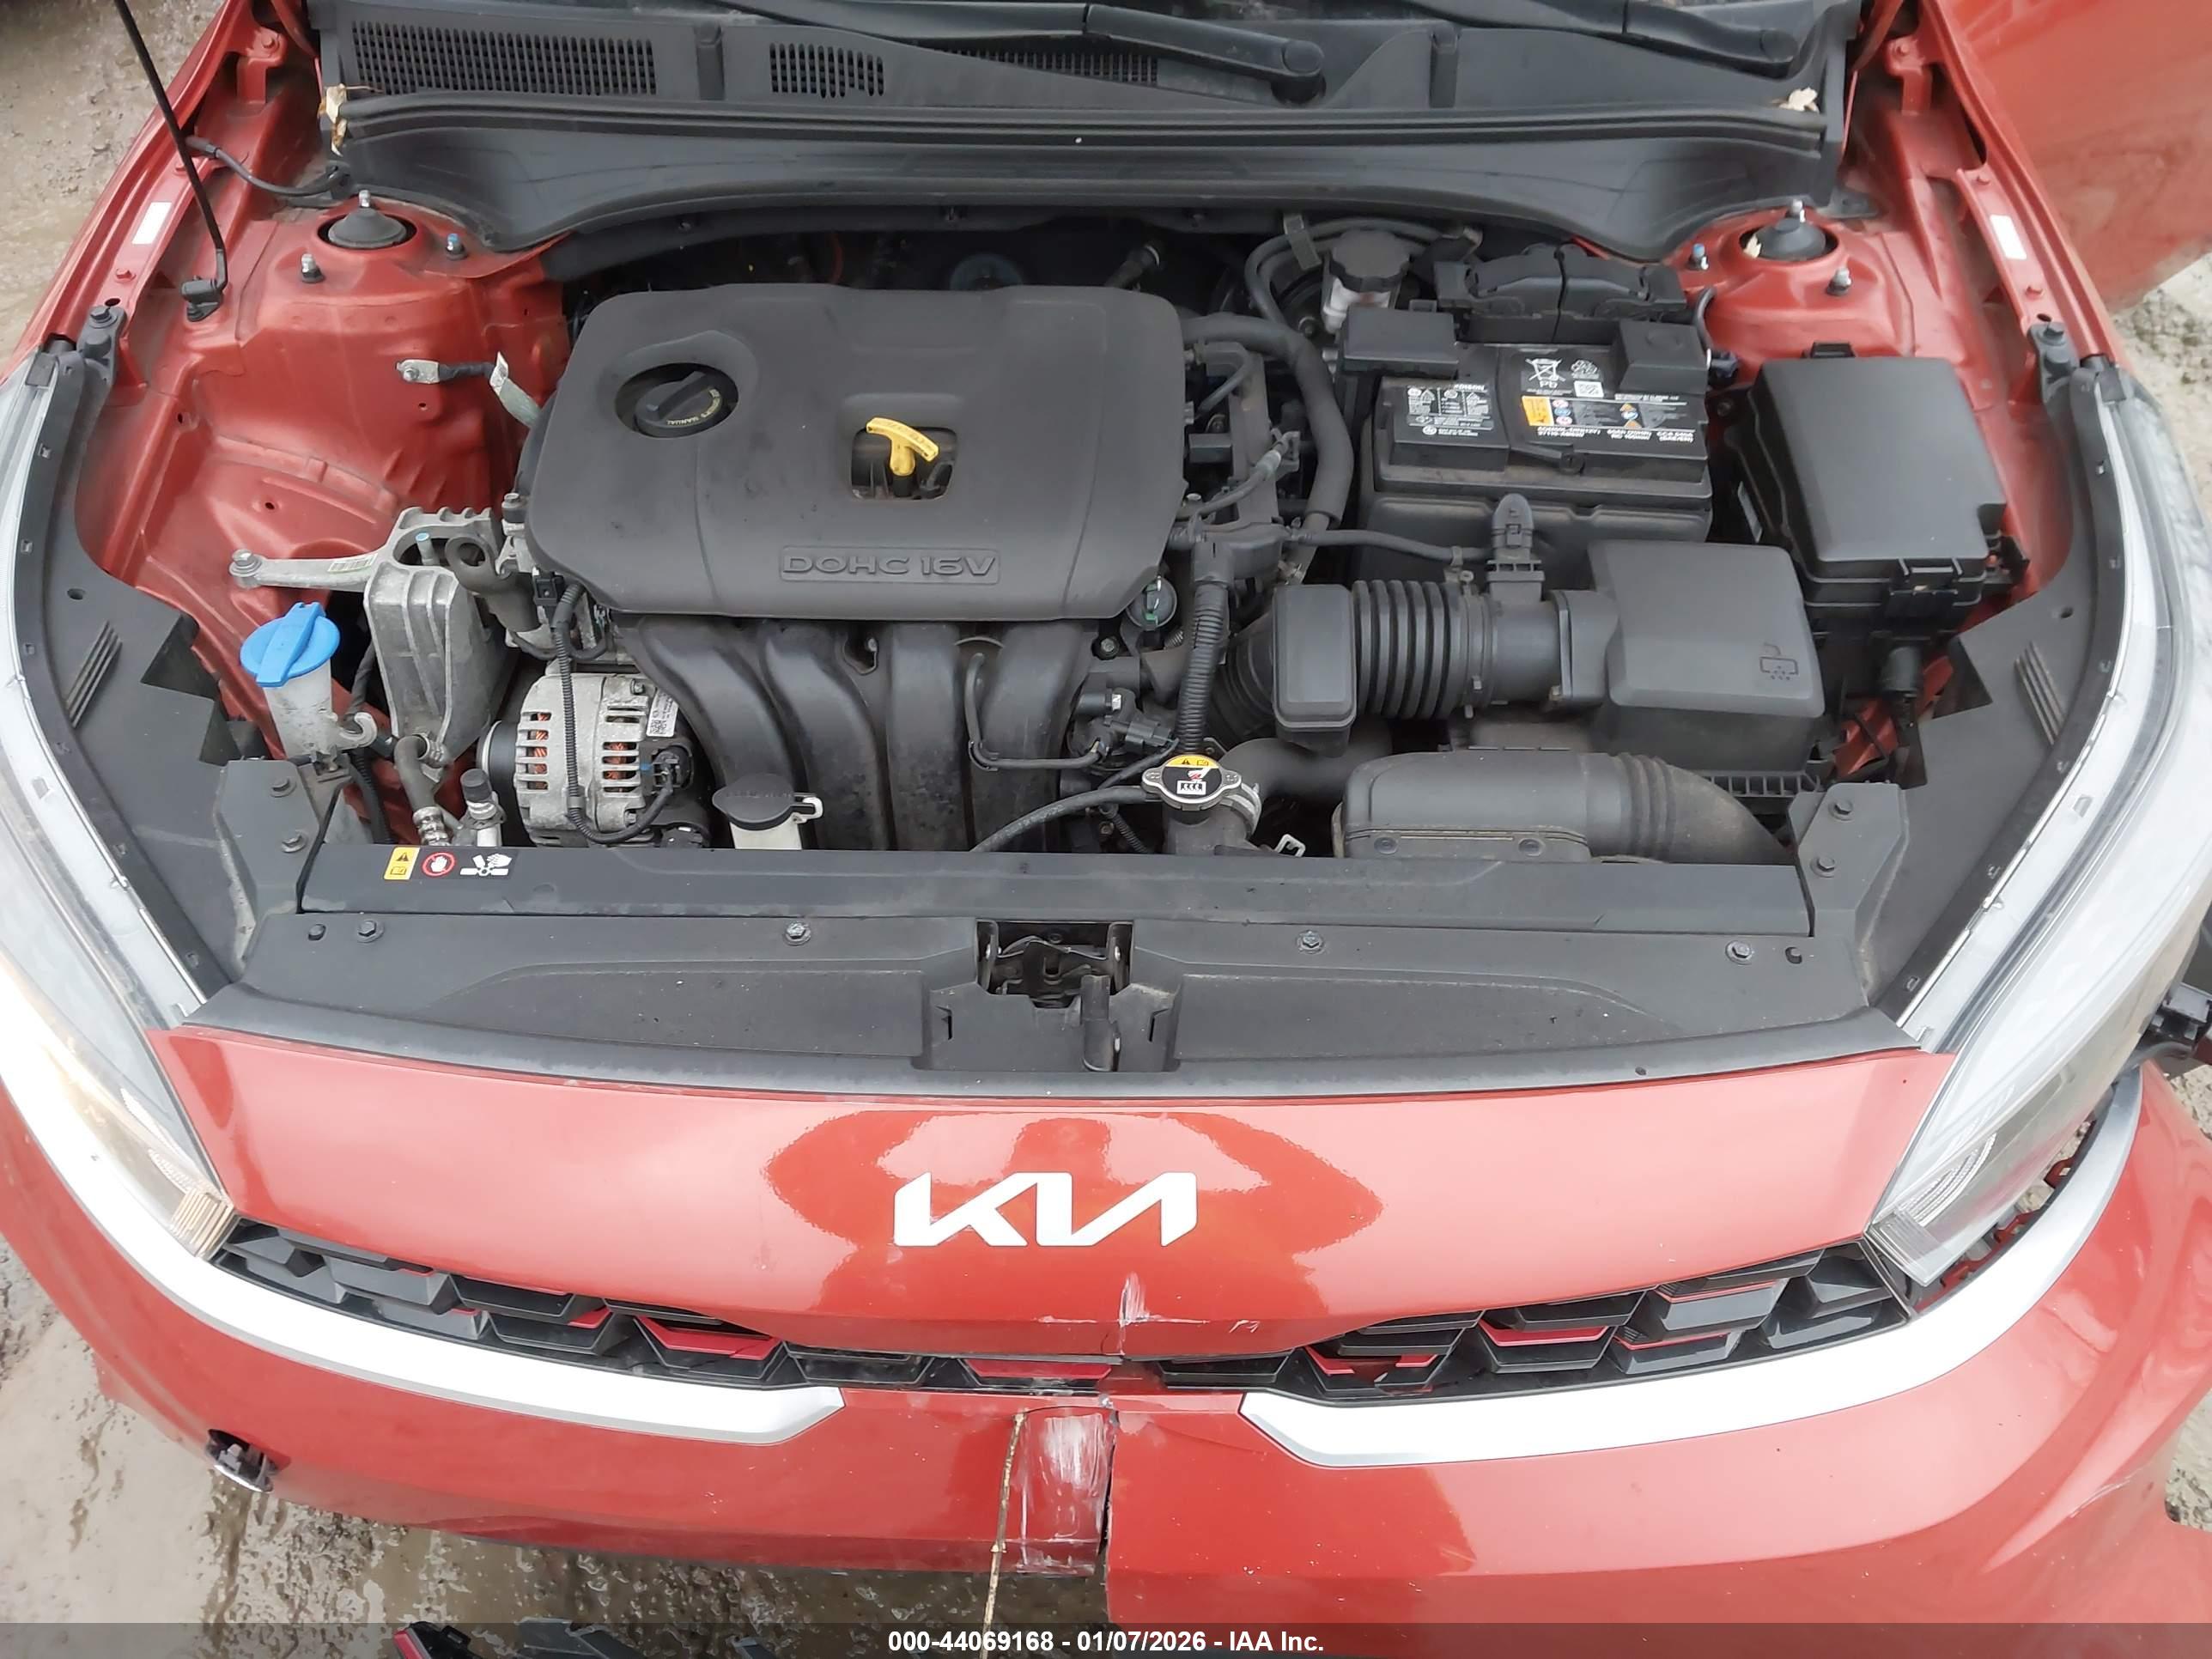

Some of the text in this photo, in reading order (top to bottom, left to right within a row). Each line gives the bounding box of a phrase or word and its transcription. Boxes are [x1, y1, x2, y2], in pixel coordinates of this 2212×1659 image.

[782, 556, 996, 576] DOHC 16V
[894, 1171, 1197, 1246] KIA
